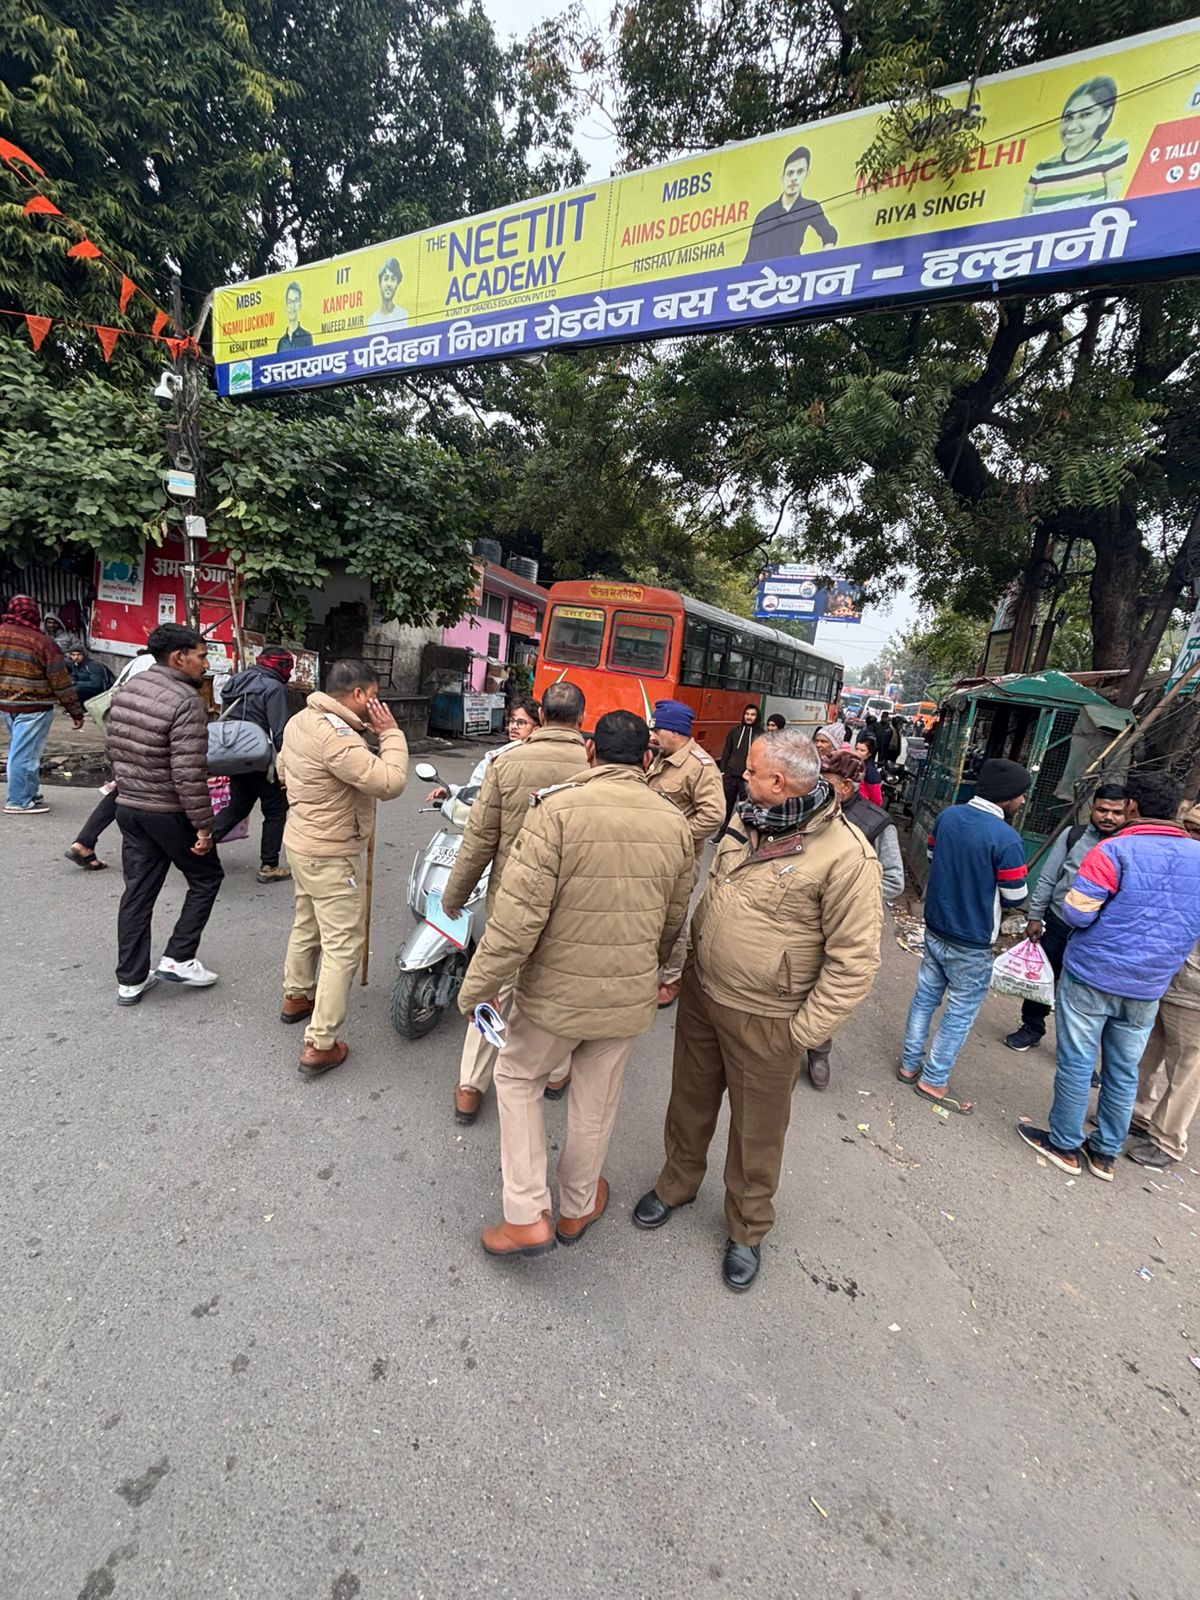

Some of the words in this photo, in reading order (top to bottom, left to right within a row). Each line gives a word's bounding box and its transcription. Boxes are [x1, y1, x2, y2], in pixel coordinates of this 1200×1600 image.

[946, 138, 1027, 177] ELHI
[1165, 140, 1200, 160] TALLI
[662, 171, 712, 203] MBBS
[875, 202, 917, 226] RIYA
[922, 189, 986, 217] SINGH
[426, 234, 447, 253] THE
[448, 192, 597, 272] NEETIIT
[620, 219, 665, 248] AIIMS
[669, 200, 749, 236] DEOGHAR
[632, 250, 676, 273] RISHAV
[677, 241, 725, 265] MISHRA
[336, 267, 351, 286] IIT
[445, 251, 566, 305] ACADEMY
[236, 291, 262, 310] MBBS
[260, 351, 349, 383] उत्तराखण्ड
[353, 335, 440, 367] परिवहन
[448, 320, 528, 353] निगम
[534, 296, 644, 340] रोडवेज
[653, 287, 718, 320] बस
[727, 266, 861, 312] स्टेशन
[920, 207, 1138, 288] हल्द्वानी
[323, 290, 363, 314] KANPUR
[464, 306, 471, 314] OF
[498, 294, 531, 309] EDUCATION
[532, 291, 544, 302] PVT
[545, 289, 556, 299] LTD
[223, 320, 244, 337] KGMU
[245, 312, 275, 333] LUCKNOW
[321, 318, 345, 334] MUFEED
[347, 315, 364, 331] AMIR
[229, 340, 248, 354] KESHAV
[250, 337, 268, 351] KUMAR
